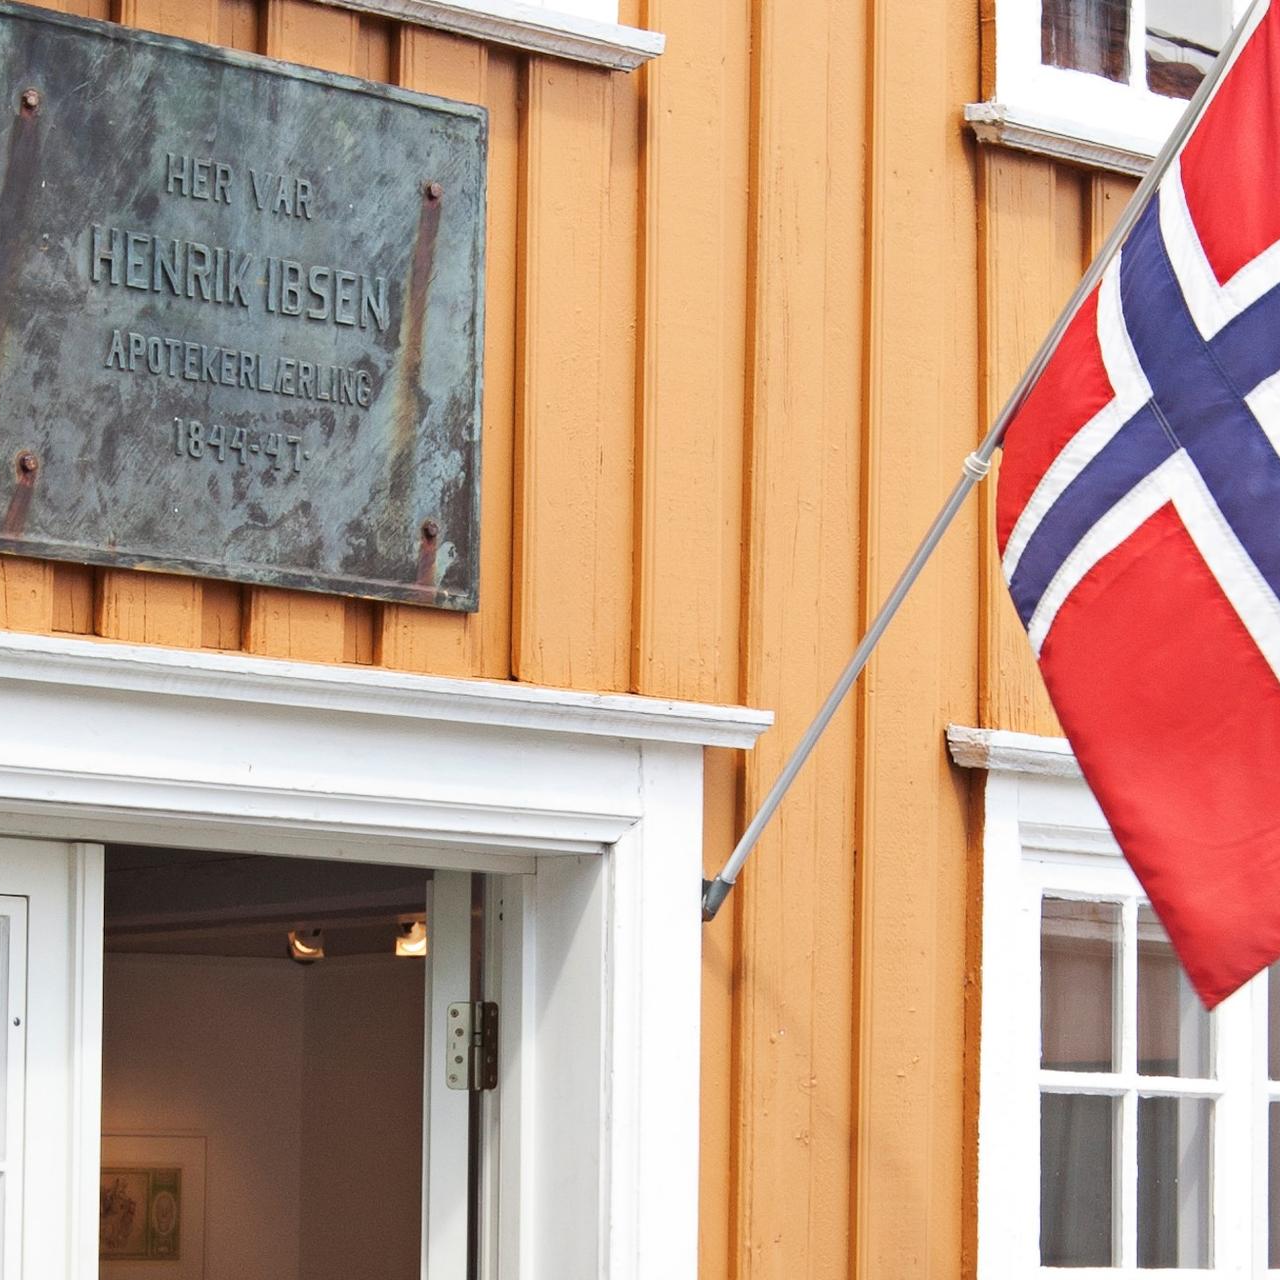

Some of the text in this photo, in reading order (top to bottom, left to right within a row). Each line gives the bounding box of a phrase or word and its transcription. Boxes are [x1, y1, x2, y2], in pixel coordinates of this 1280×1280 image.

[165, 152, 314, 220] HER VAR
[89, 224, 391, 333] HENRIK IBSEN
[104, 329, 372, 408] APOTEKERLÆRLING
